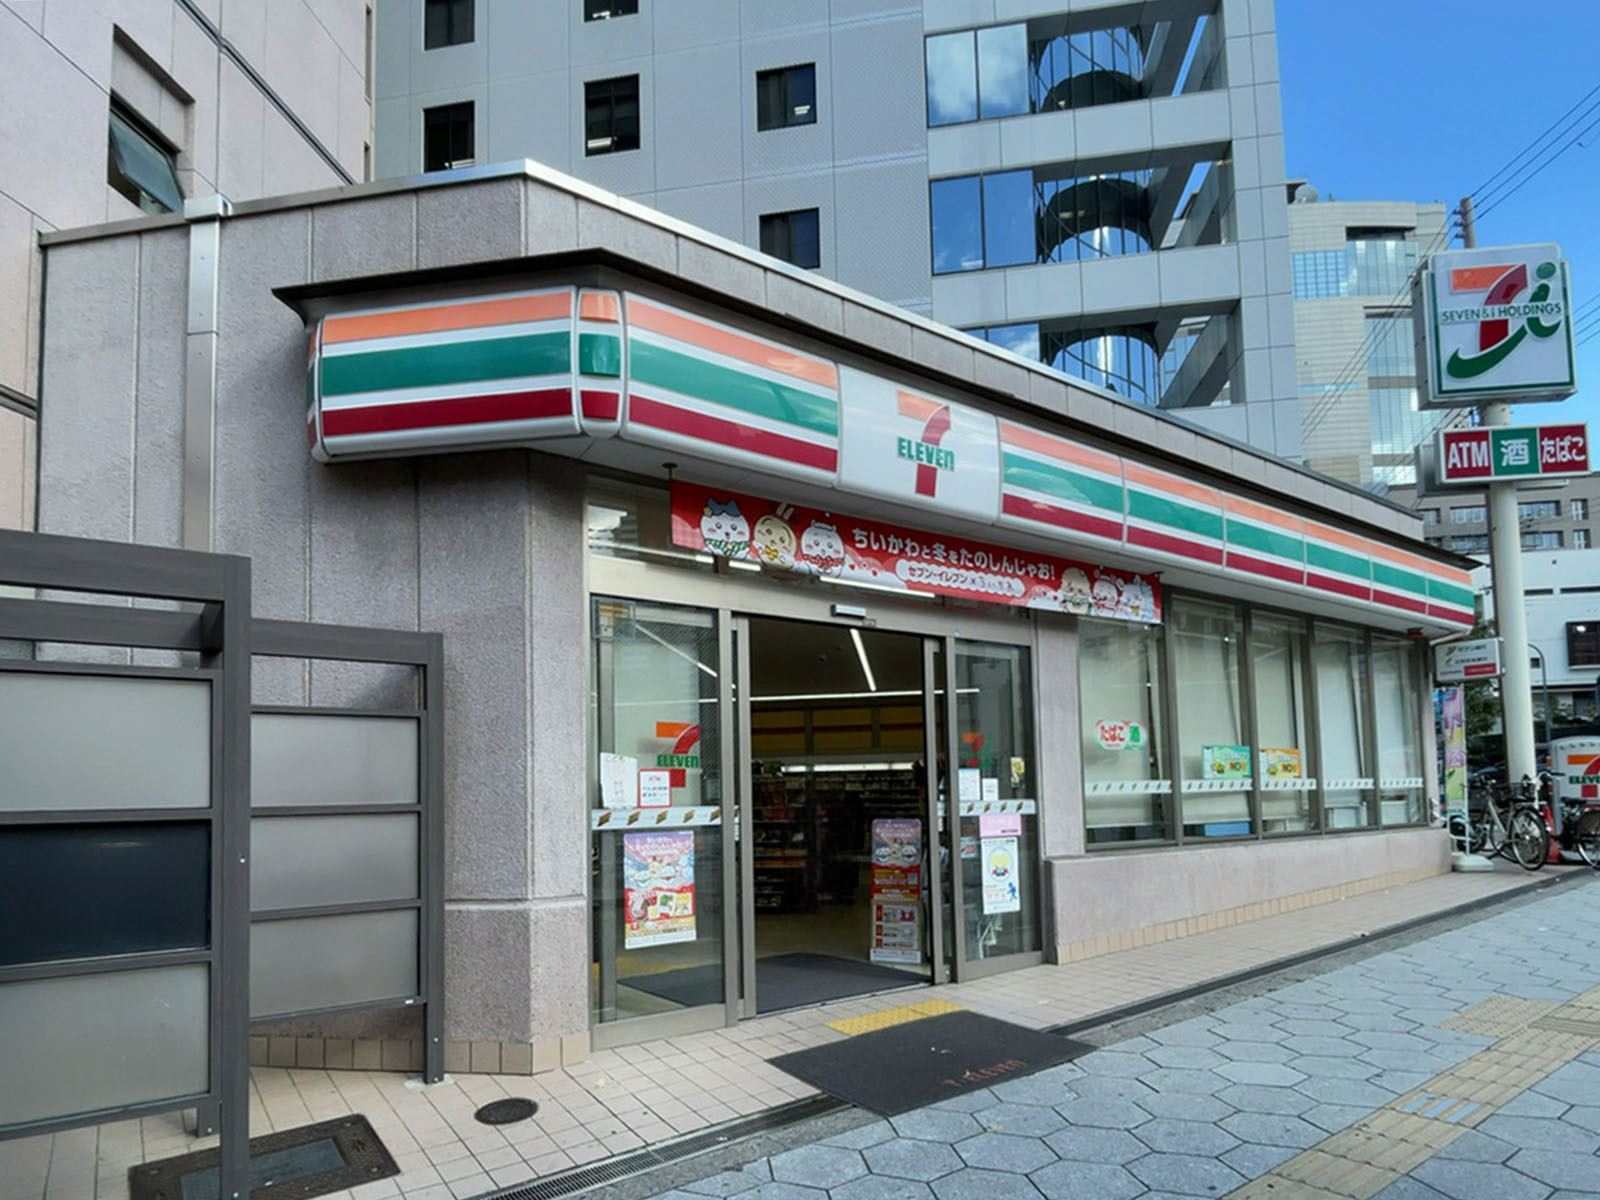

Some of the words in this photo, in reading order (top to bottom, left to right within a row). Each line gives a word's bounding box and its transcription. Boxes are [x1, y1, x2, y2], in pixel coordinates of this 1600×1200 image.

[1498, 302, 1562, 318] HOLDINGS
[1447, 440, 1490, 470] ATM
[1501, 438, 1530, 466] 酒
[1541, 436, 1587, 464] たばこ
[1100, 725, 1125, 742] たばこ
